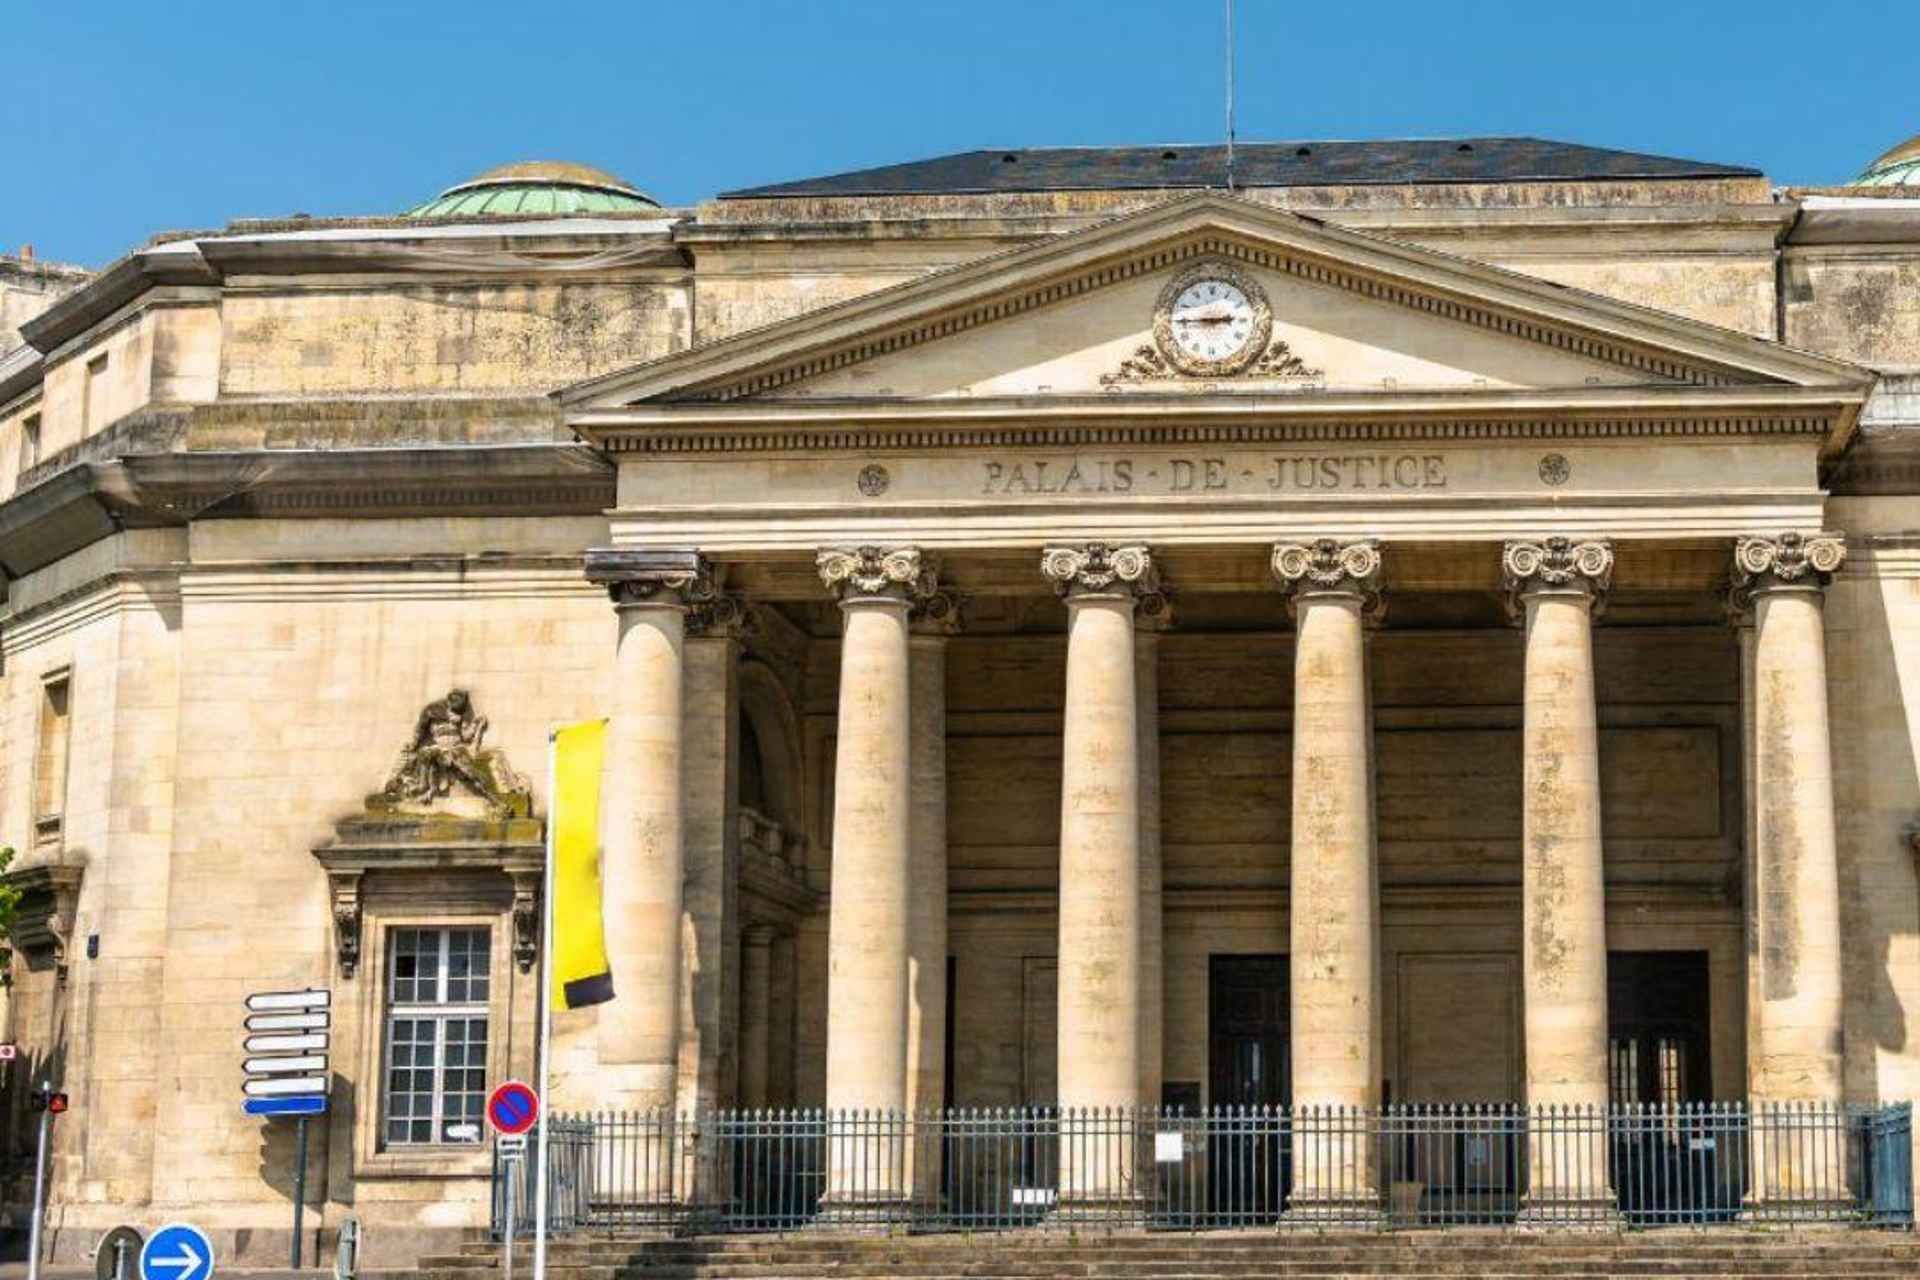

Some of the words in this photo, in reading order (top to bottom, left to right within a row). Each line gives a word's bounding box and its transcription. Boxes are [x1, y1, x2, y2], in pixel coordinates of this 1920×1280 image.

[982, 460, 1132, 493] PALAIS
[1169, 459, 1226, 490] DE
[1267, 455, 1446, 488] JUSTICE
